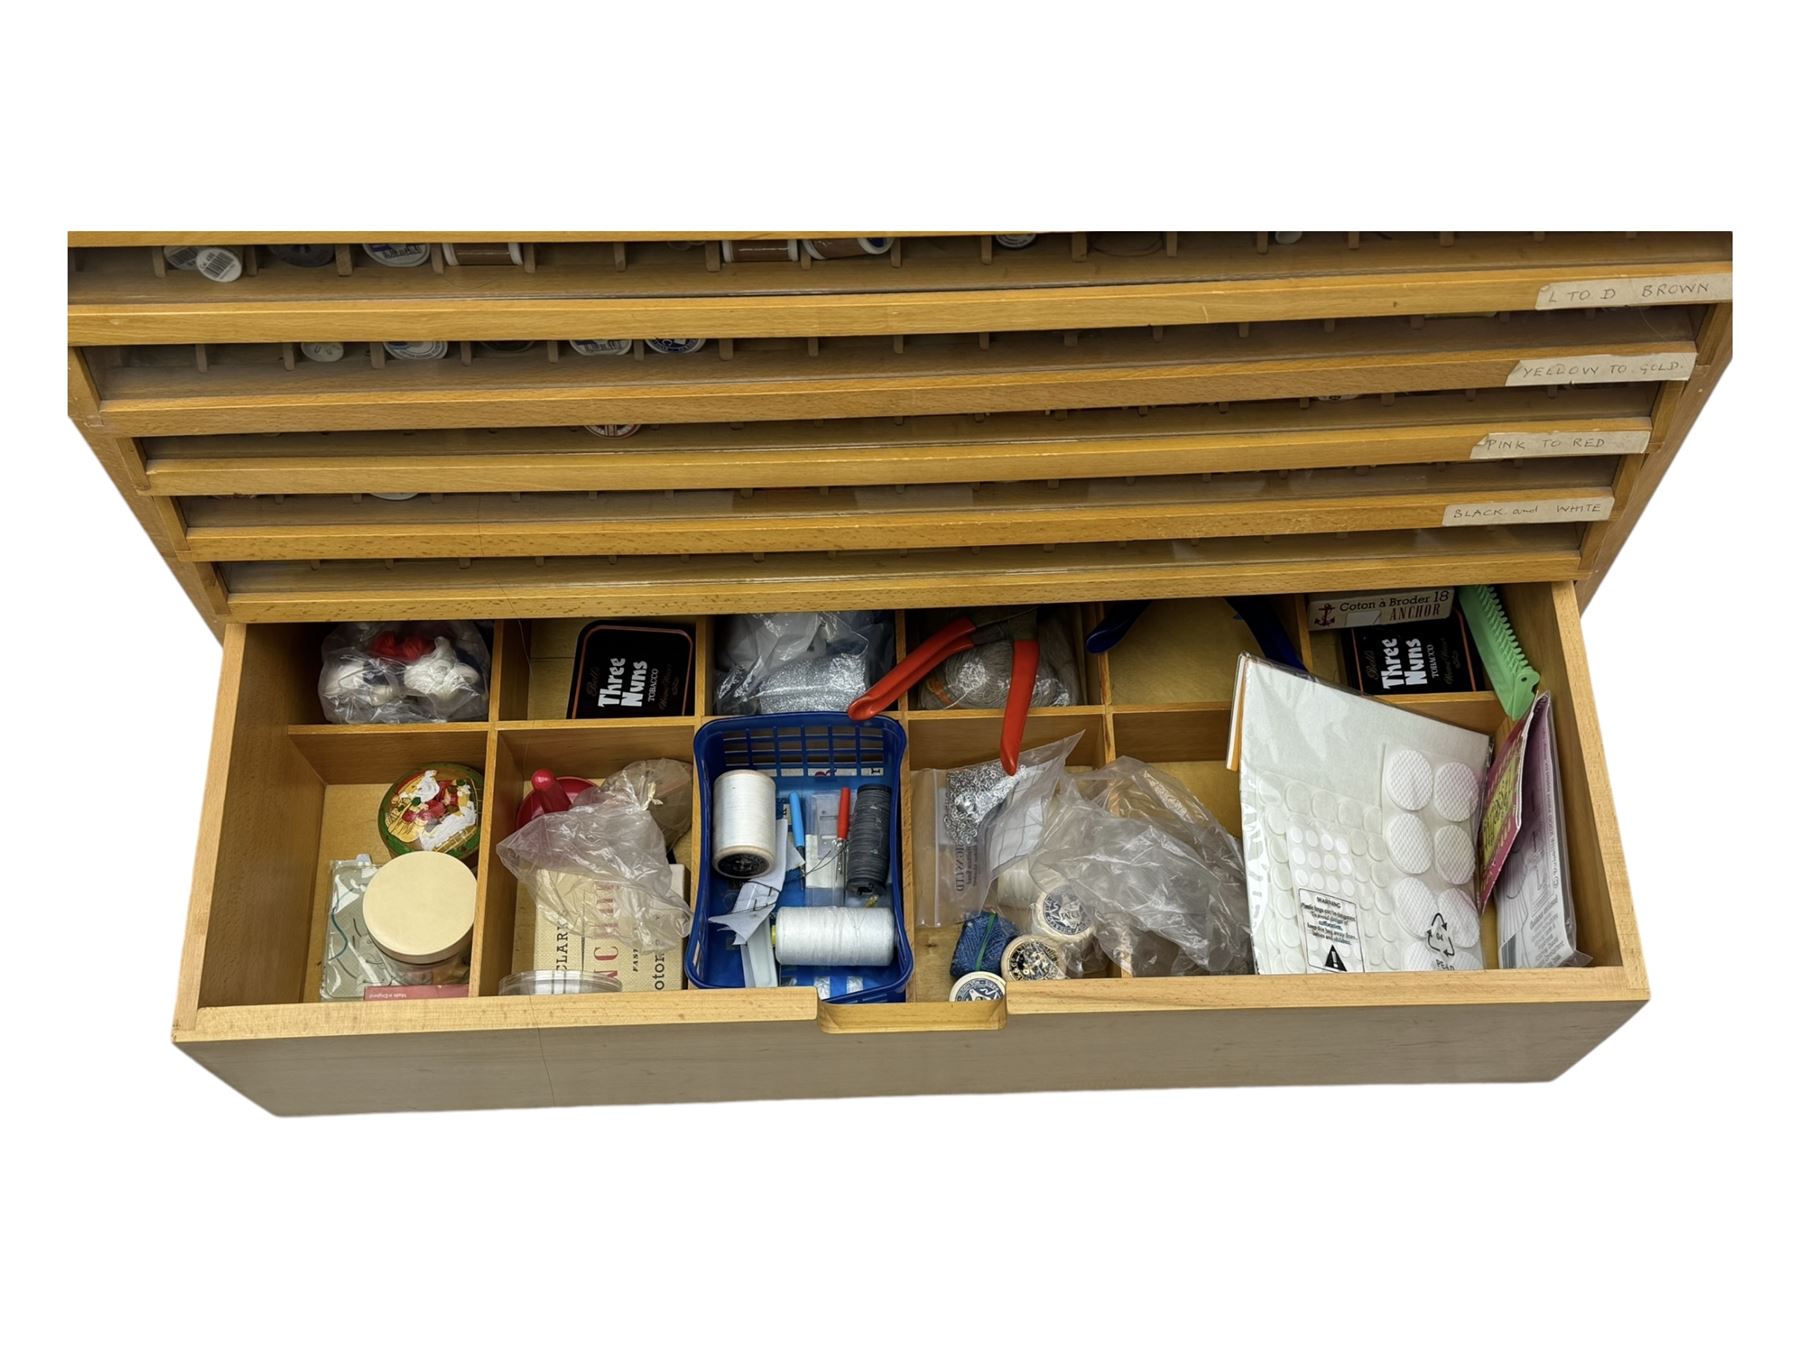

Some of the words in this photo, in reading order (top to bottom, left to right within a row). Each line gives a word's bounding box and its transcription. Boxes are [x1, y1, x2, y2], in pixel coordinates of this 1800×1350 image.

[1567, 288, 1591, 301] TO
[1599, 288, 1617, 300] D
[1641, 282, 1710, 298] BROWN
[1609, 364, 1628, 375] TO
[1484, 437, 1526, 451] PINK
[1541, 437, 1562, 449] TO
[1572, 437, 1606, 449] RED
[1512, 505, 1539, 516] and
[1556, 503, 1602, 514] WHITE
[1339, 599, 1376, 612] Coton
[1379, 598, 1387, 608] à
[1389, 593, 1432, 608] Broder
[1433, 590, 1449, 603] 18
[1389, 602, 1441, 621] ANCHOR
[1380, 637, 1405, 690] Three
[1404, 638, 1428, 686] Nuns
[1426, 644, 1440, 679] TOBACCO
[597, 657, 626, 708] Three
[620, 660, 648, 707] Nuns
[648, 668, 659, 702] TOBACCO
